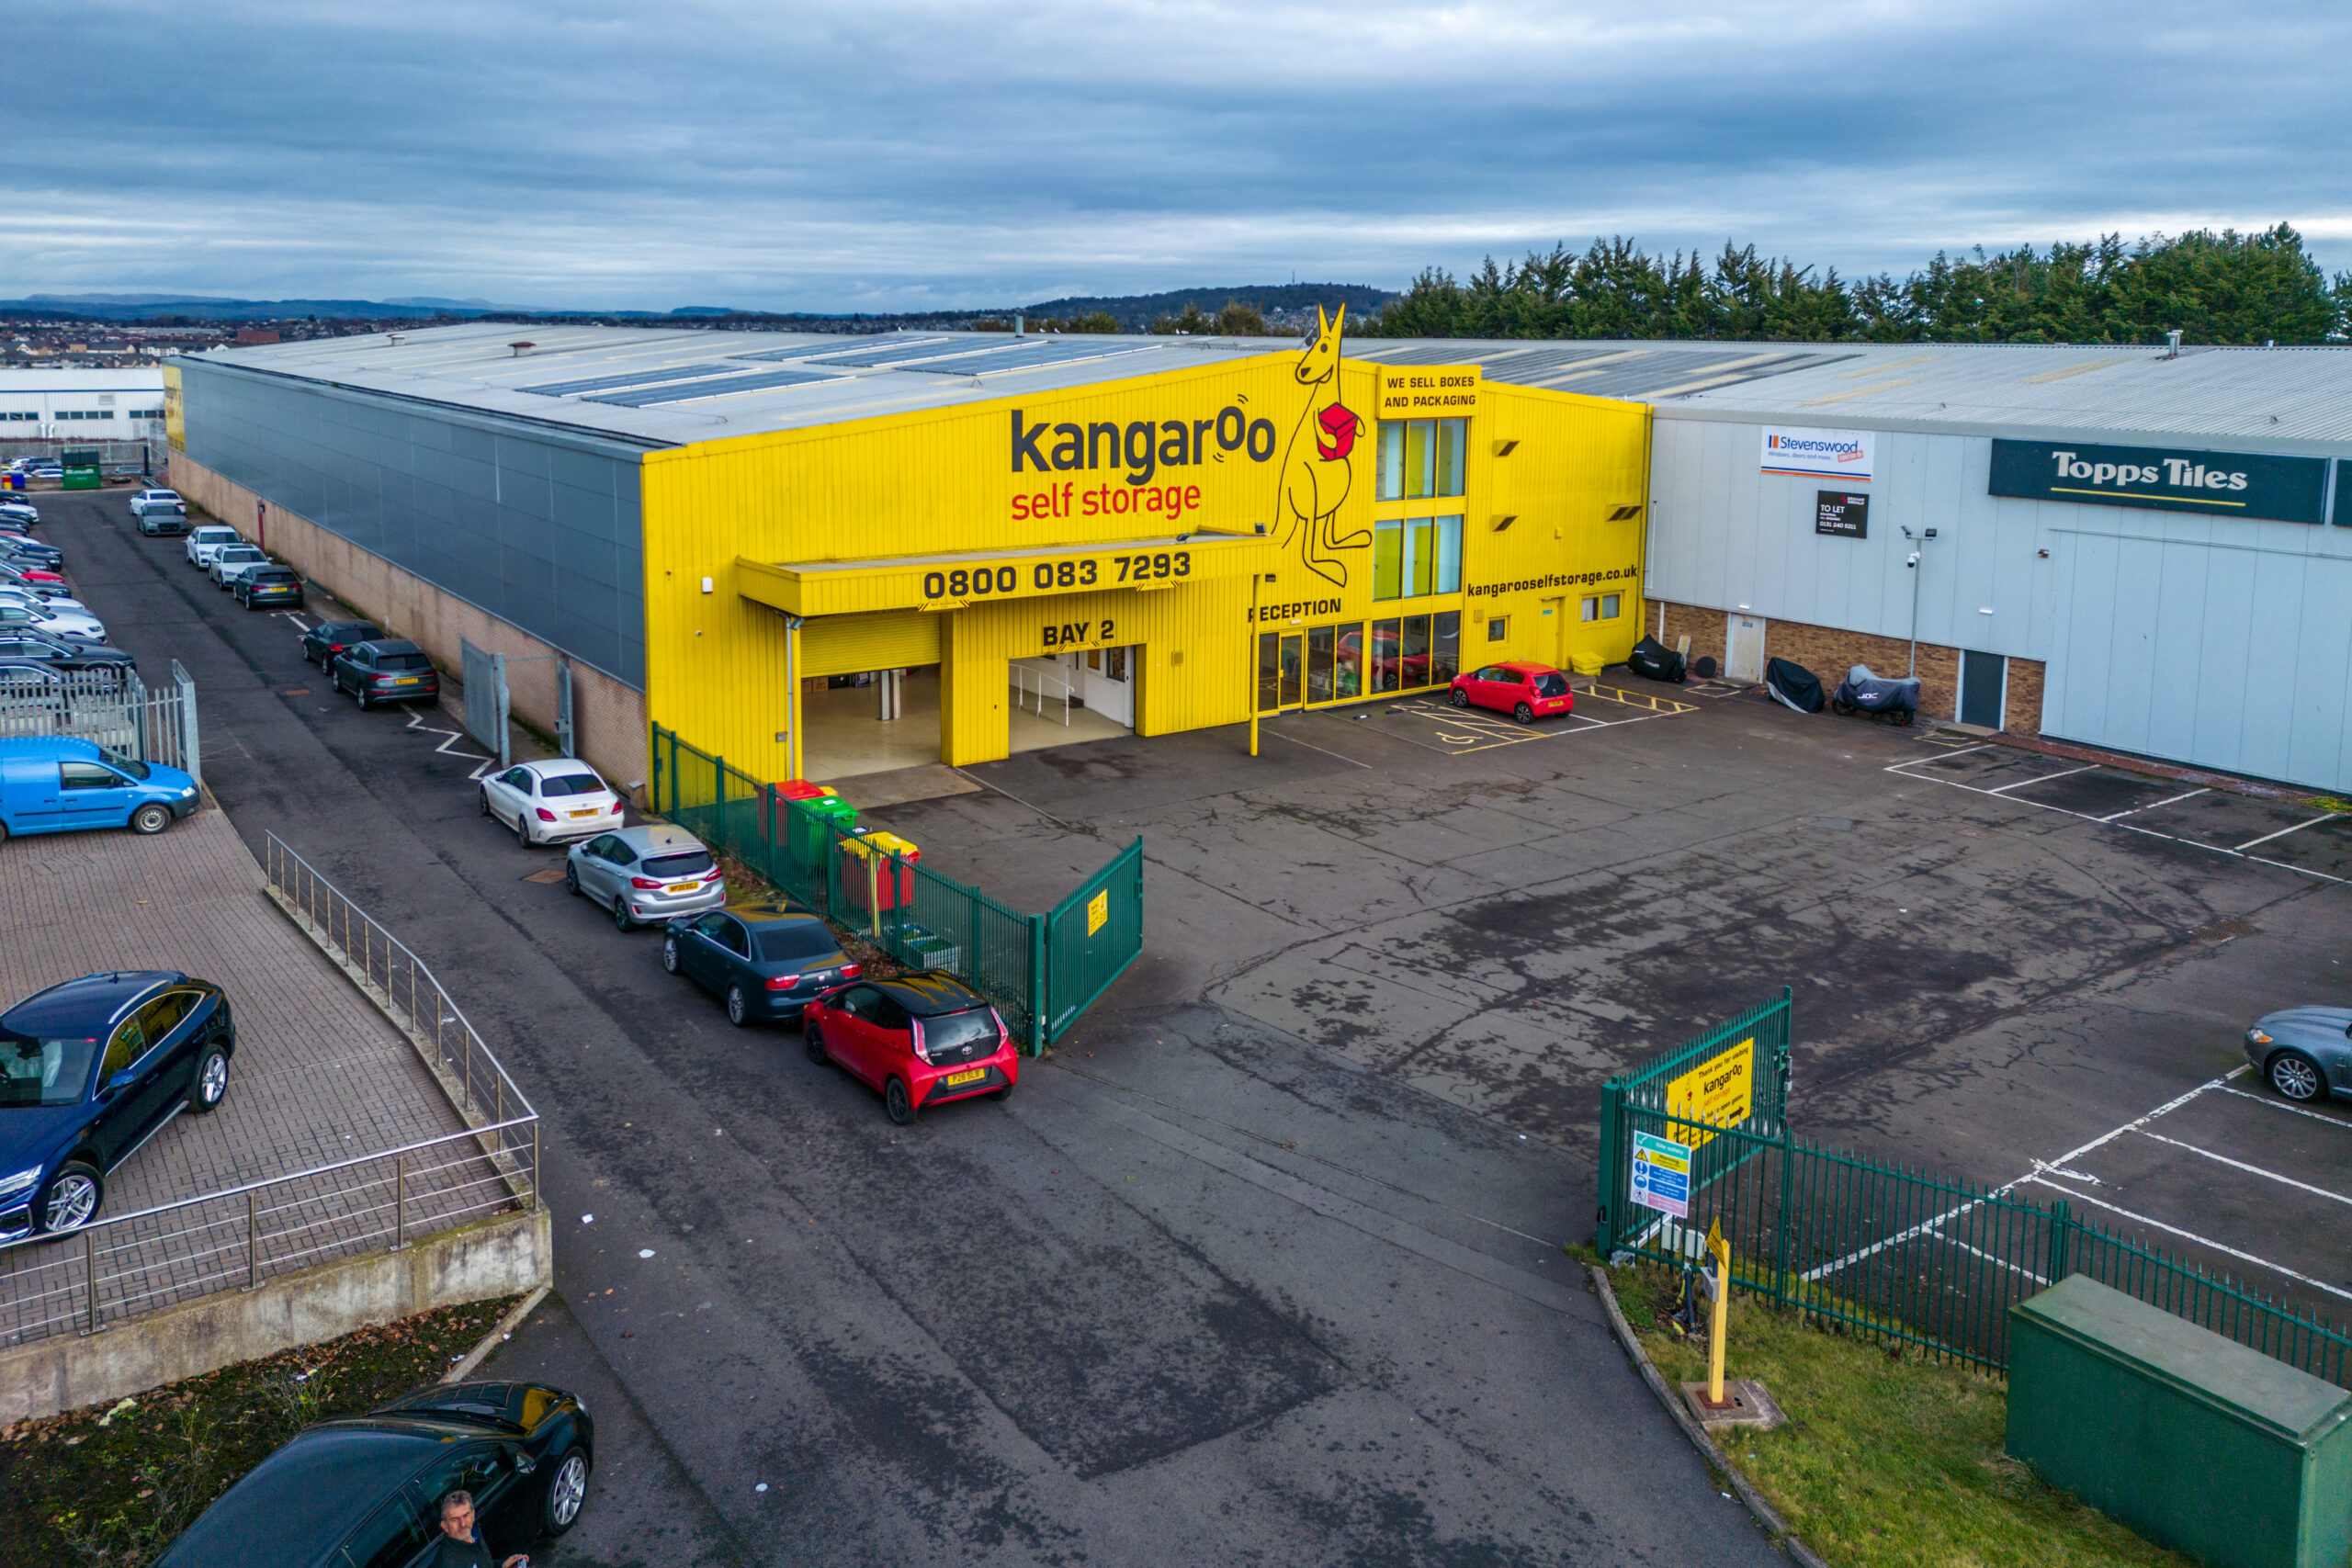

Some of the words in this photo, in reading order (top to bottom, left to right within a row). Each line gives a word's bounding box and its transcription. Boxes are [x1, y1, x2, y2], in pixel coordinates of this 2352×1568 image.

[1387, 378, 1405, 389] WE
[1409, 377, 1435, 388] SELL
[1440, 377, 1475, 388] BOXES
[1385, 397, 1408, 408] AND
[1413, 395, 1476, 407] PACKAGING
[1011, 405, 1276, 486] kangaroo
[1780, 436, 1859, 453] Stevenswood
[2052, 451, 2159, 486] Topps
[2163, 458, 2248, 491] Tiles
[1011, 481, 1073, 521] self
[1081, 482, 1201, 520] storage
[1820, 504, 1831, 513] TO
[1832, 505, 1845, 513] LET
[924, 566, 1017, 599] 0800
[1034, 559, 1098, 590] 083
[1114, 552, 1191, 582] 7293
[1467, 564, 1637, 598] kangarooselfstorage.co.uk
[1043, 622, 1089, 647] BAY
[1101, 620, 1114, 640] 2
[1698, 1066, 1713, 1079] Thank
[1713, 1062, 1723, 1072] you
[1724, 1056, 1732, 1066] for
[1732, 1047, 1749, 1061] visiting
[1703, 1065, 1743, 1096] kangaroo
